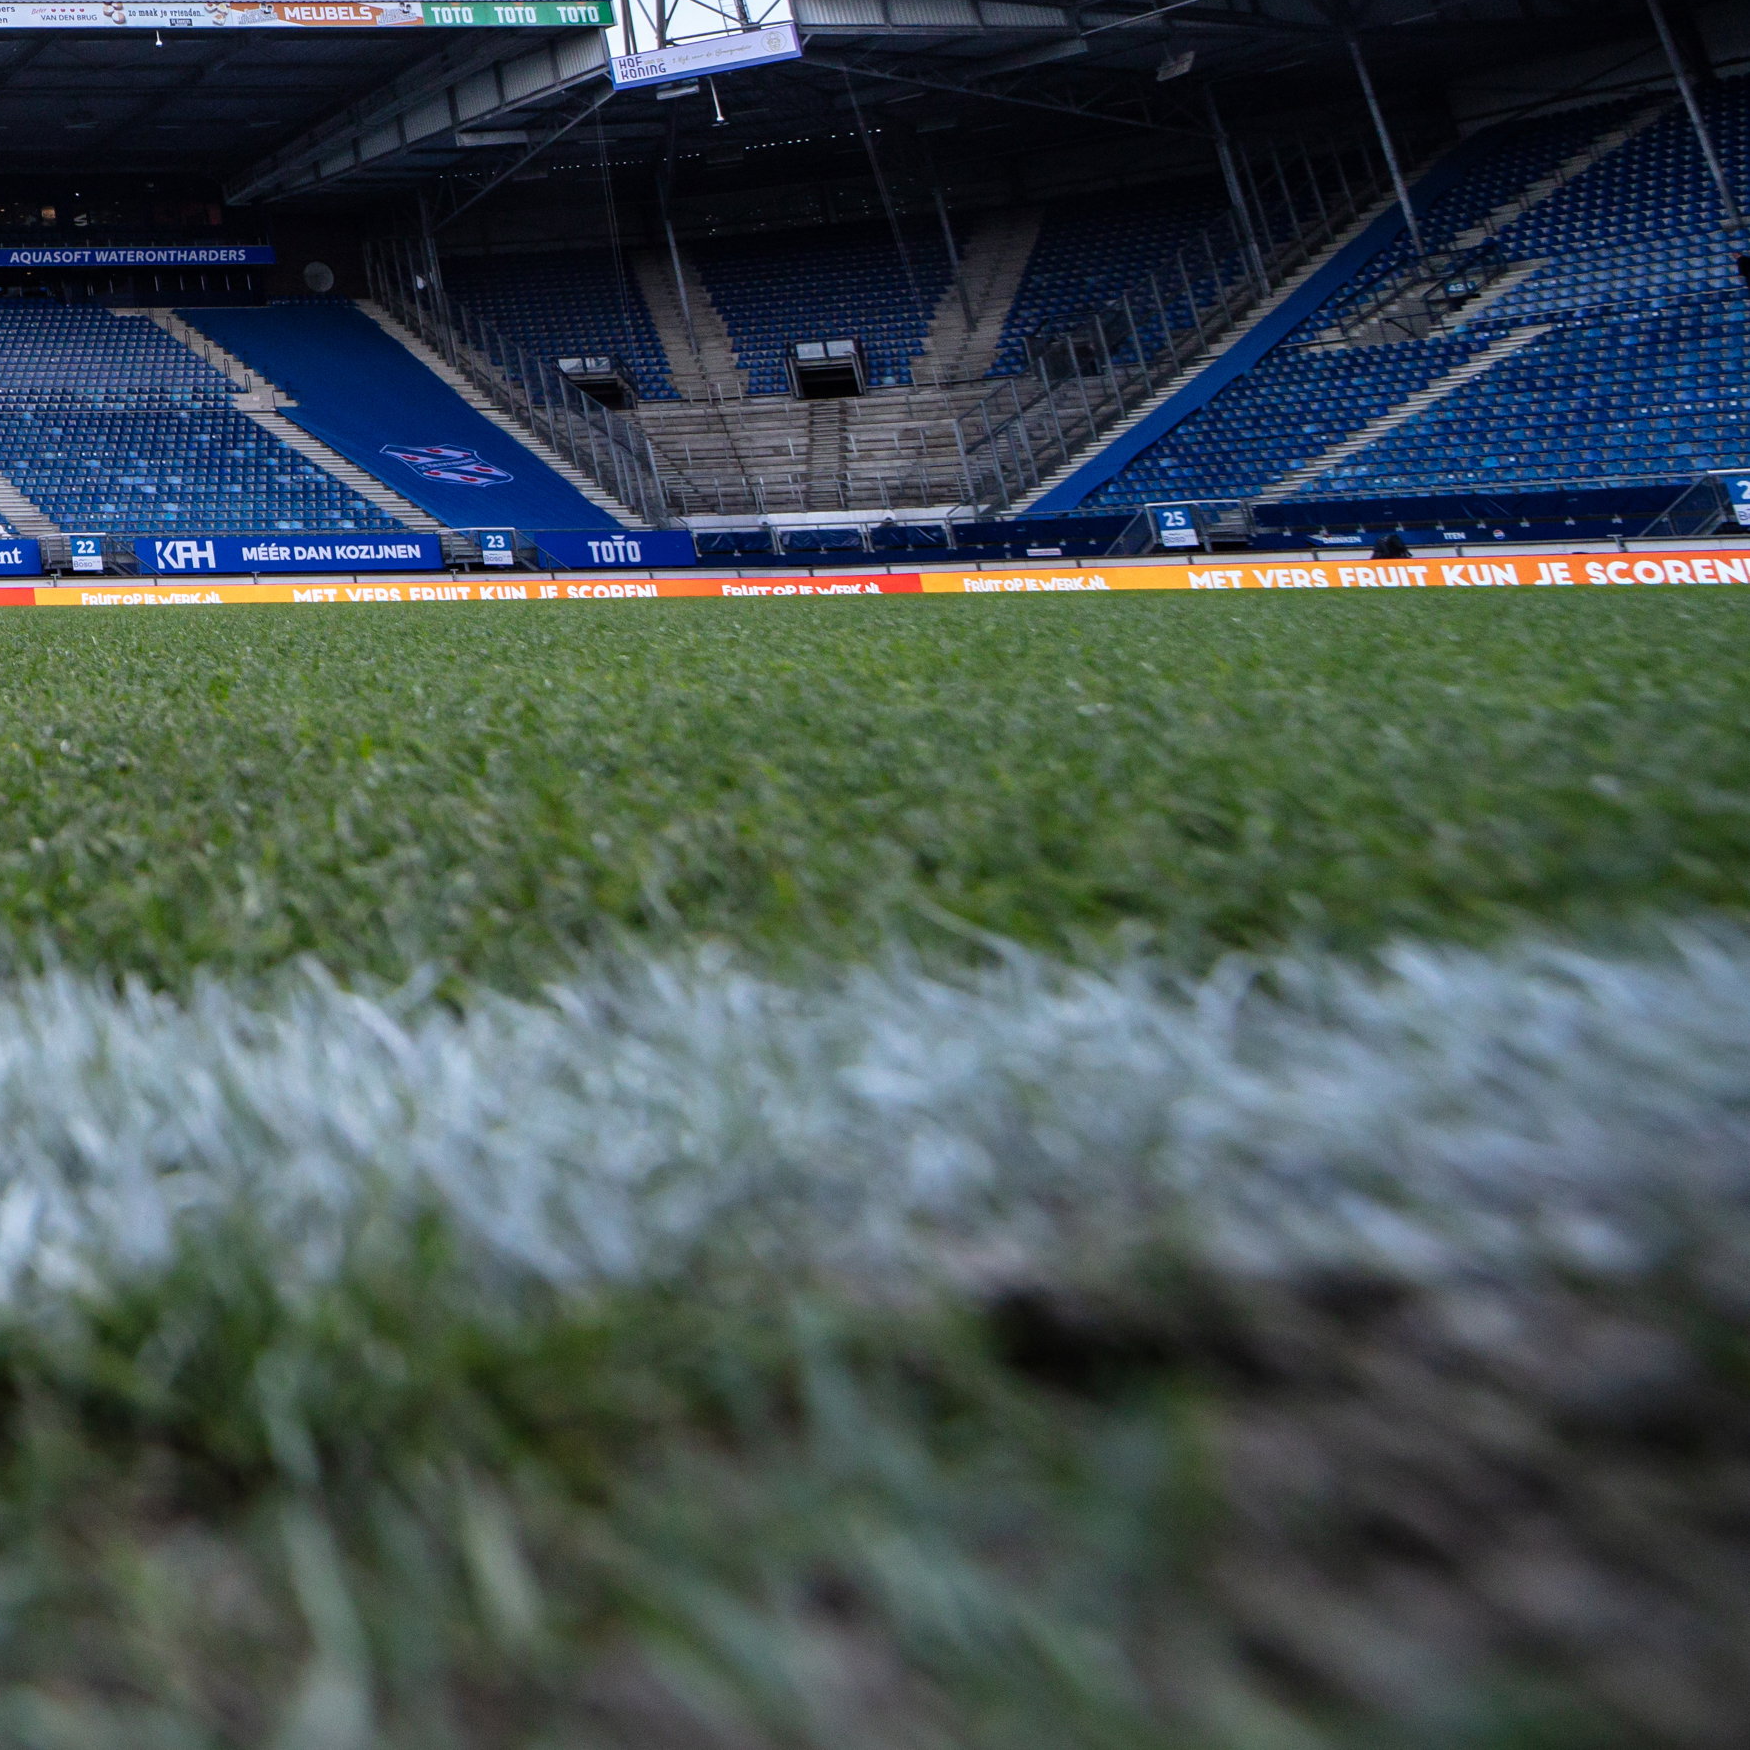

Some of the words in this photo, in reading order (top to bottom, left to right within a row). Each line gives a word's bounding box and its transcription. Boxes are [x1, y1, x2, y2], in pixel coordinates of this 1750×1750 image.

[284, 6, 372, 21] MEUBELS
[431, 6, 473, 24] TOTO
[557, 6, 599, 24] TOTO
[618, 56, 644, 70] HOF
[621, 63, 666, 81] KONING
[10, 251, 91, 264] AQUASOFT
[94, 250, 246, 263] WATERONTHARDERS
[1736, 480, 1750, 499] 2
[1162, 511, 1186, 527] 25
[77, 540, 96, 554] 22
[486, 535, 505, 548] 23
[155, 540, 215, 569] KFH
[242, 544, 290, 561] MÉÉR
[294, 546, 332, 560] DAN
[335, 544, 421, 559] KOZIJNEN
[588, 540, 642, 563] TOTO
[1188, 570, 1243, 589] MET
[1253, 569, 1326, 588] VERS
[1338, 566, 1427, 587] FRUIT
[1441, 564, 1517, 586] KUN
[1534, 563, 1568, 585] JE
